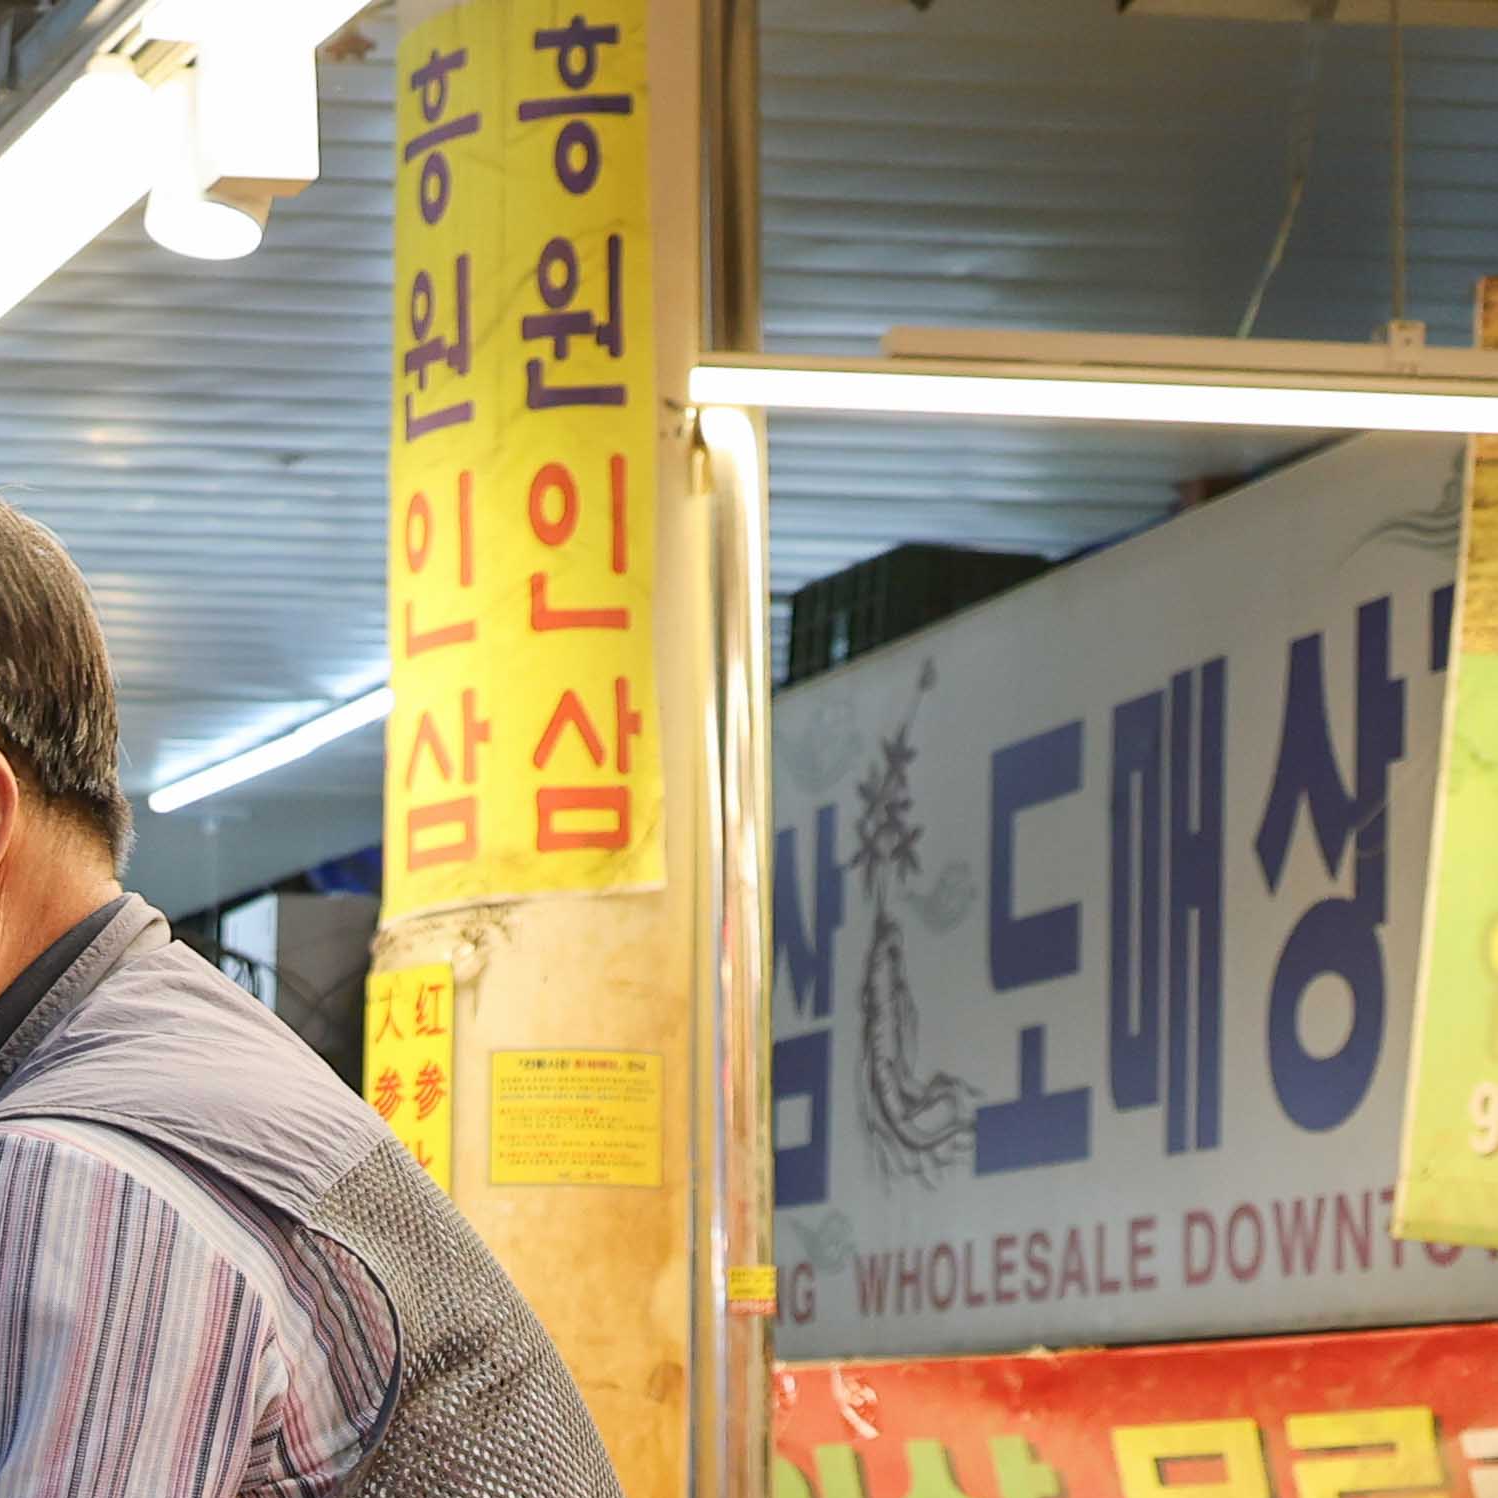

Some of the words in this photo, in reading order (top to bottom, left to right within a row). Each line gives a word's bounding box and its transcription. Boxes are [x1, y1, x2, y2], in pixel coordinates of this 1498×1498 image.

[975, 584, 1456, 1178] 도매상
[853, 1215, 1158, 1317] WHOLESALE
[1182, 1184, 1498, 1287] DOWN
